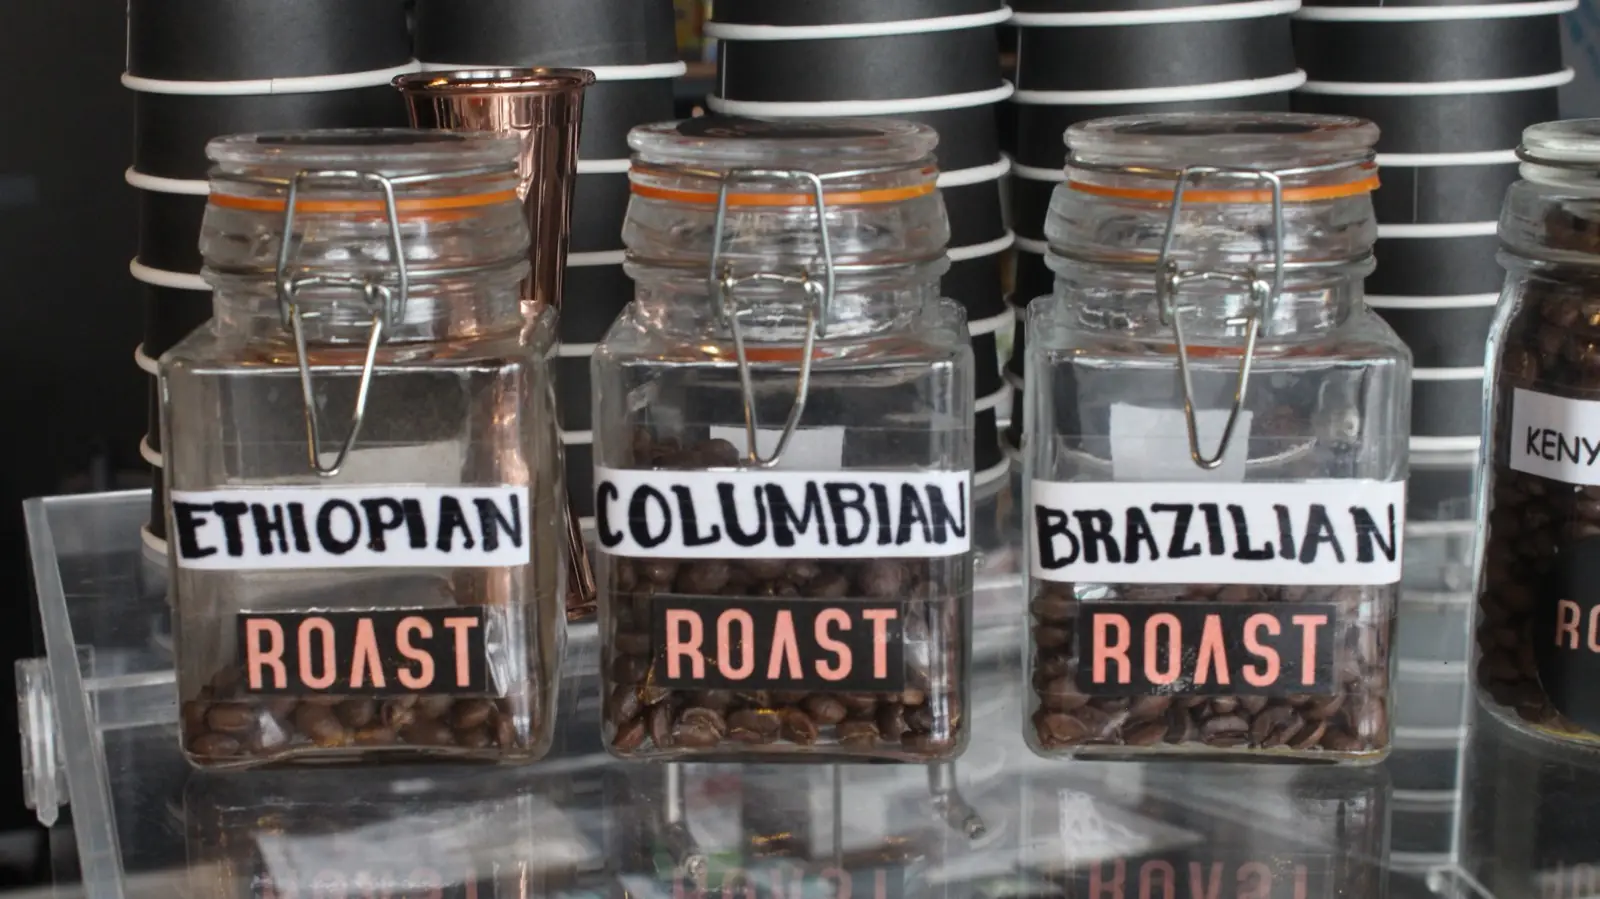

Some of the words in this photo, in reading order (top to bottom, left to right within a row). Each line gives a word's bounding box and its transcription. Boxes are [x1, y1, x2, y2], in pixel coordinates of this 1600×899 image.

[1526, 425, 1600, 466] KENY
[172, 494, 522, 559] ETHIOPIAN
[597, 480, 966, 549] COLUMBIAN
[1035, 502, 1397, 570] BRAZILIAN
[245, 616, 479, 690] ROAST
[665, 607, 898, 682] ROAST
[1092, 612, 1328, 688] ROAST
